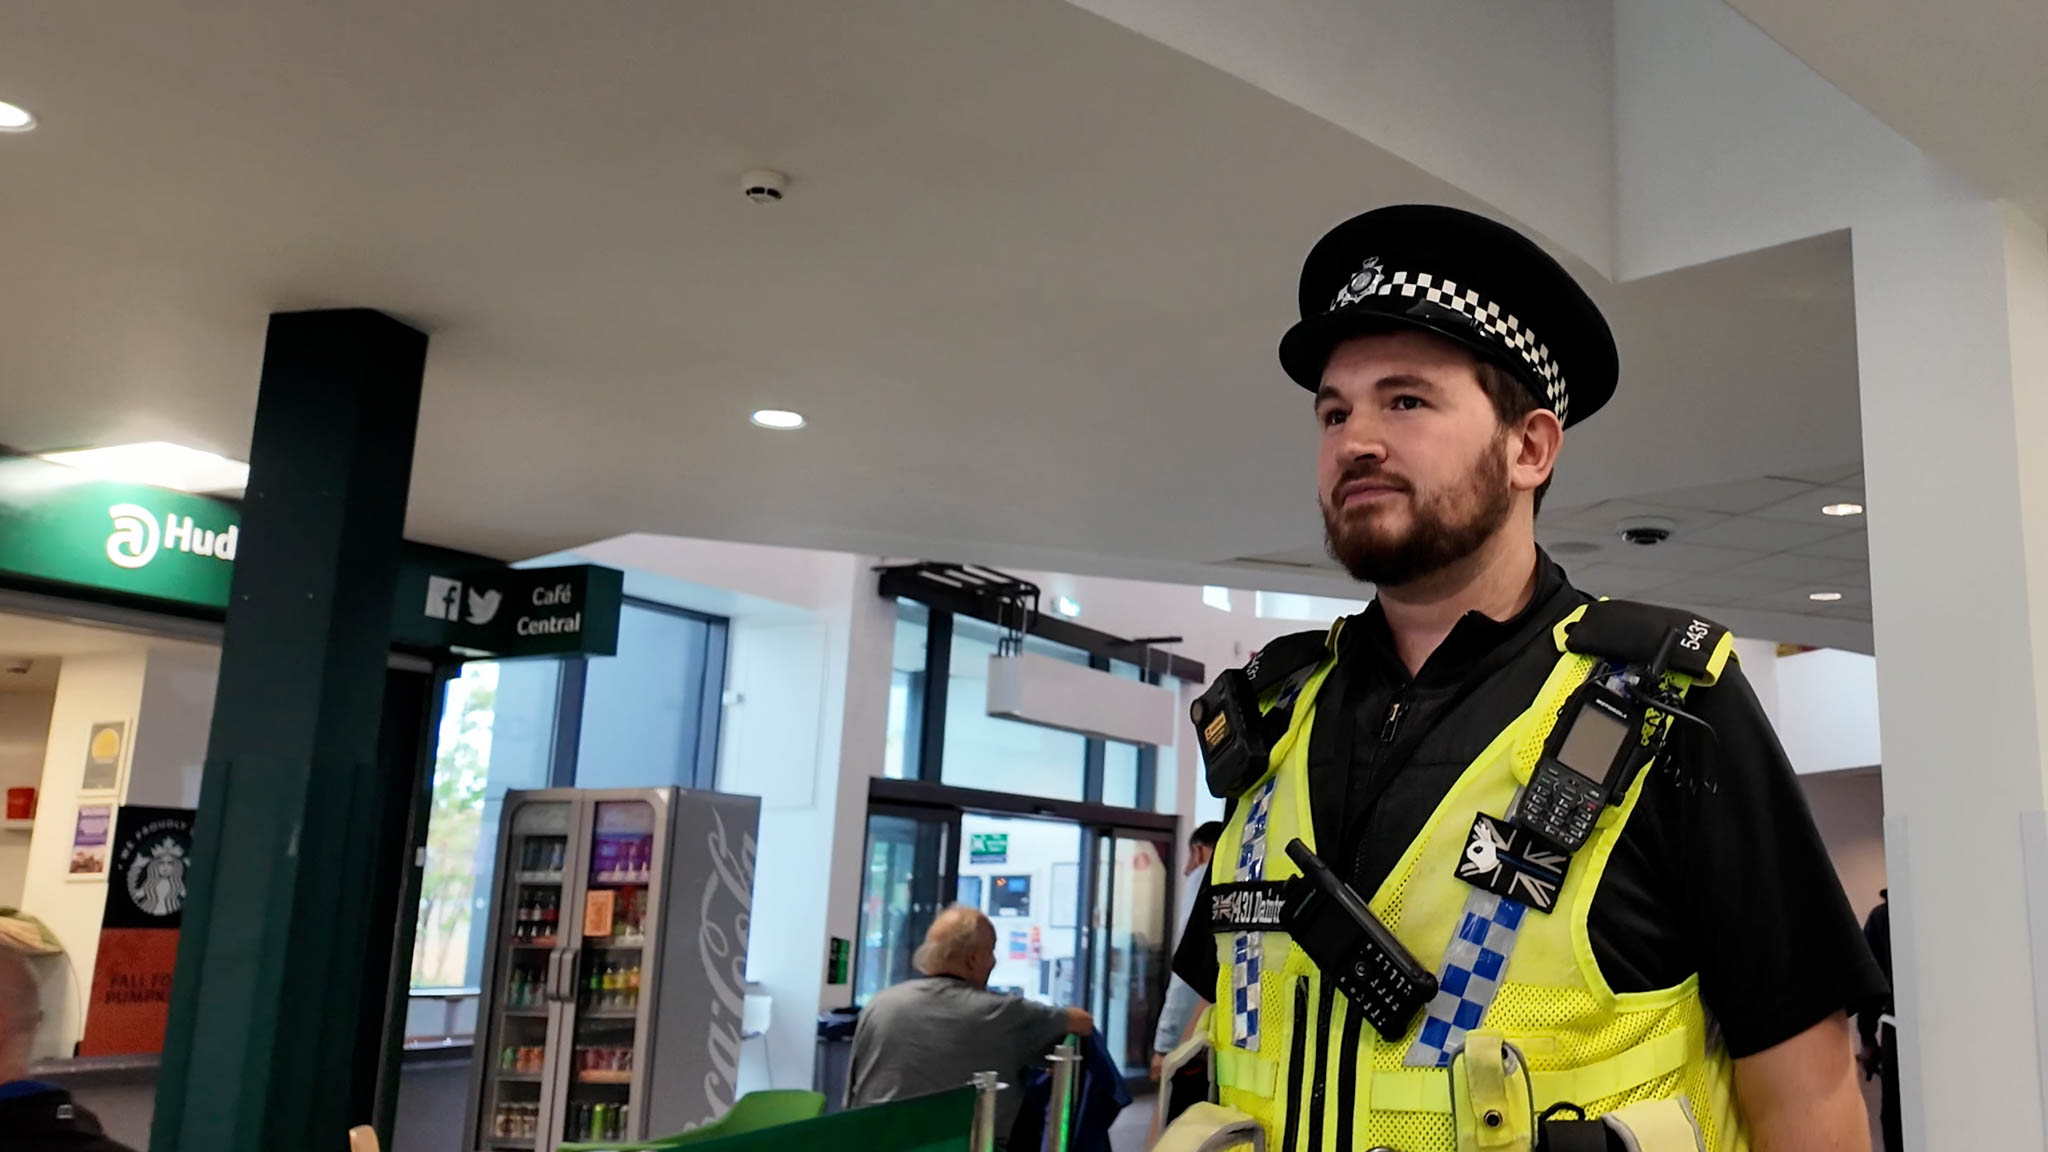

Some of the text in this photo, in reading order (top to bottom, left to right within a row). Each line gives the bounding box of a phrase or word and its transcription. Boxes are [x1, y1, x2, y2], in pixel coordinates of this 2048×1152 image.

[532, 583, 572, 607] Café
[516, 611, 582, 636] Central
[1679, 618, 1711, 651] 5431
